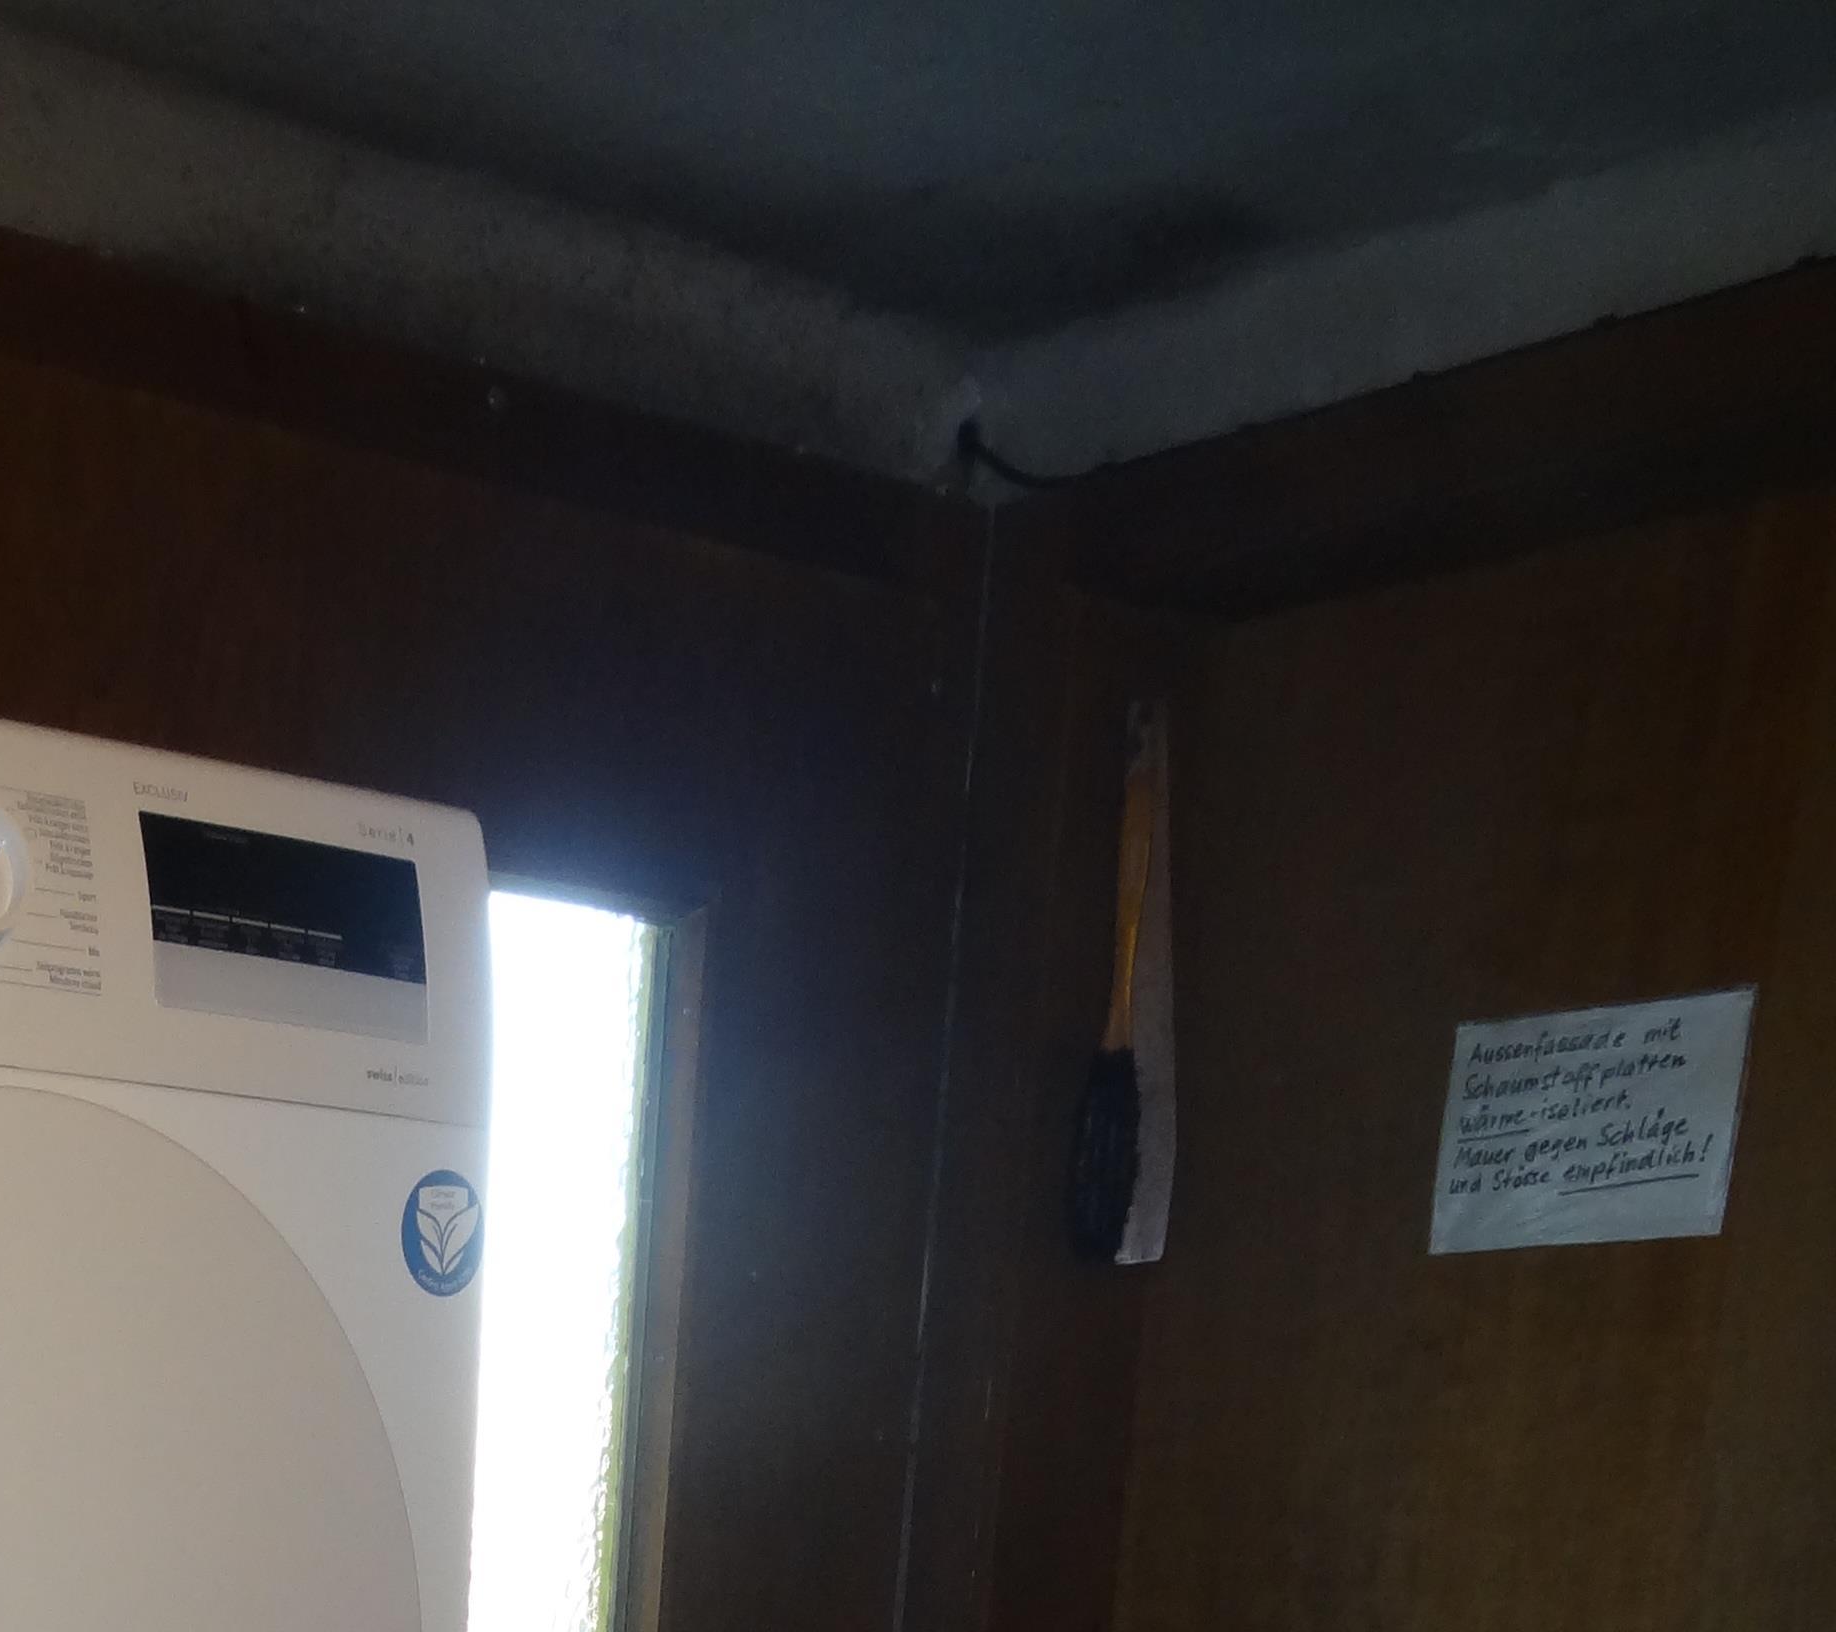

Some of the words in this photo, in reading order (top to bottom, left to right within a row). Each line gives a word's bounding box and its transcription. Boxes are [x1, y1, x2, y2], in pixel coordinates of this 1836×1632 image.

[1468, 1028, 1627, 1066] Aussenfassade
[1643, 1017, 1682, 1043] mit
[1449, 1173, 1482, 1195] und
[1492, 1164, 1553, 1191] Stösse
[1563, 1134, 1714, 1181] empfindlich!
[1454, 1145, 1515, 1169] Mauer
[1523, 1134, 1588, 1162] gegen
